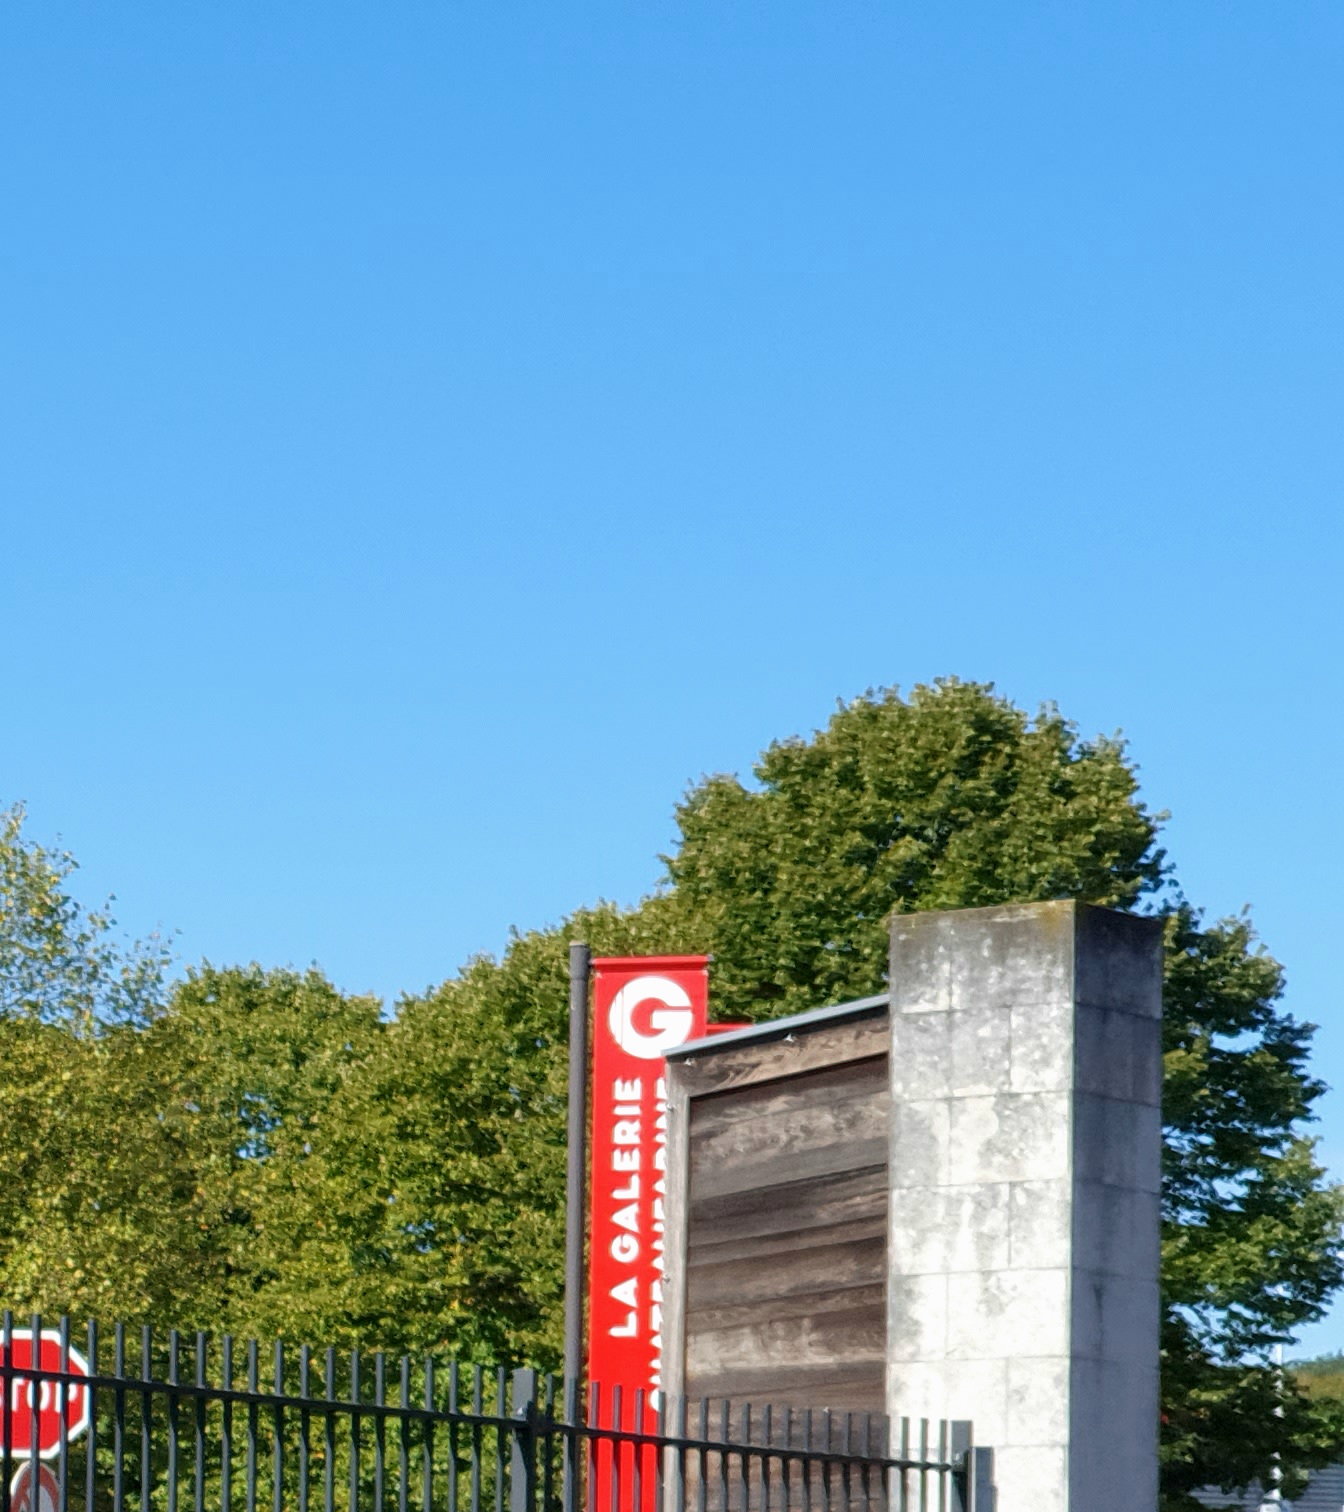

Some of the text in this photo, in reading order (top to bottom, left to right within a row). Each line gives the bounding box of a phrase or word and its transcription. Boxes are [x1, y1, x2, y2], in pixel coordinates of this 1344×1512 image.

[608, 975, 693, 1059] G
[608, 1077, 642, 1338] LA GALERIE
